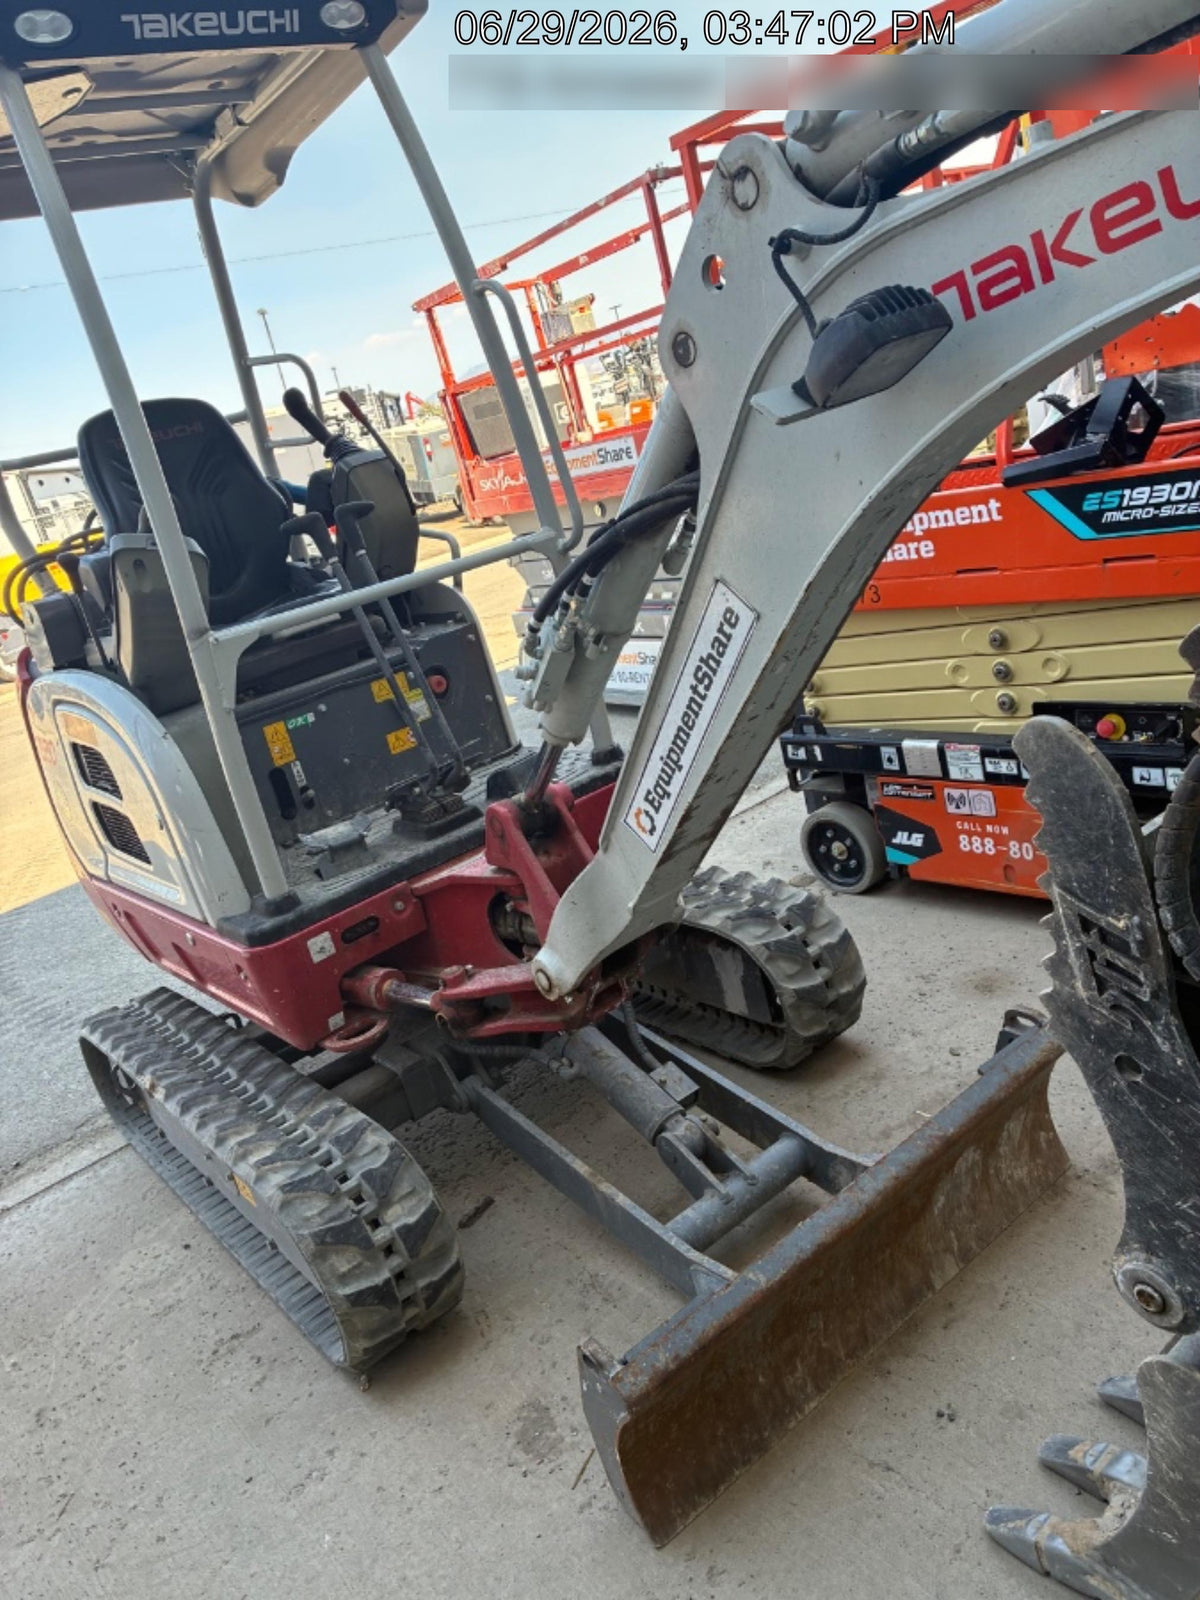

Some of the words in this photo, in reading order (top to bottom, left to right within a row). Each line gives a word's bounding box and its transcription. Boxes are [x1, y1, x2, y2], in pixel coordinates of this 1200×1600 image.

[120, 8, 300, 40] TAKEUCHI
[1102, 501, 1200, 524] MICRO-SIZE
[643, 605, 740, 815] EquipmentShare
[891, 831, 926, 848] JLG
[956, 820, 982, 833] CALL
[986, 823, 1010, 836] NOW
